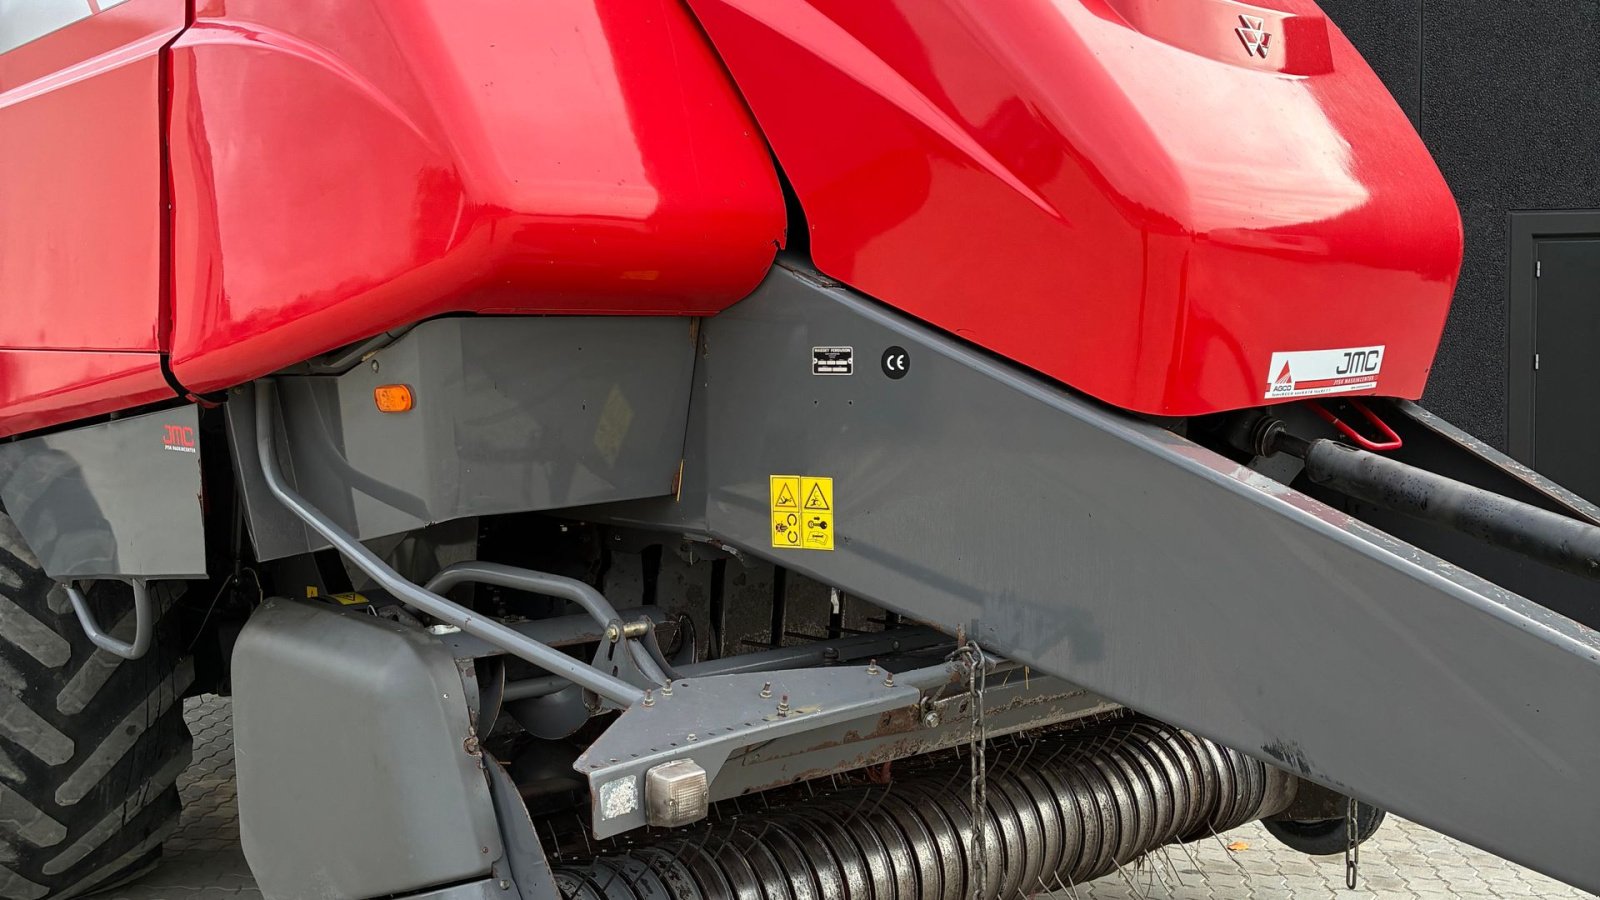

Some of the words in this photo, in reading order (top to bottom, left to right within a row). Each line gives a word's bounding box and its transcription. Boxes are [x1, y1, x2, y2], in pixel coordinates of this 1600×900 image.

[886, 354, 905, 371] CE
[1336, 350, 1379, 375] JMC
[162, 424, 194, 447] JMC
